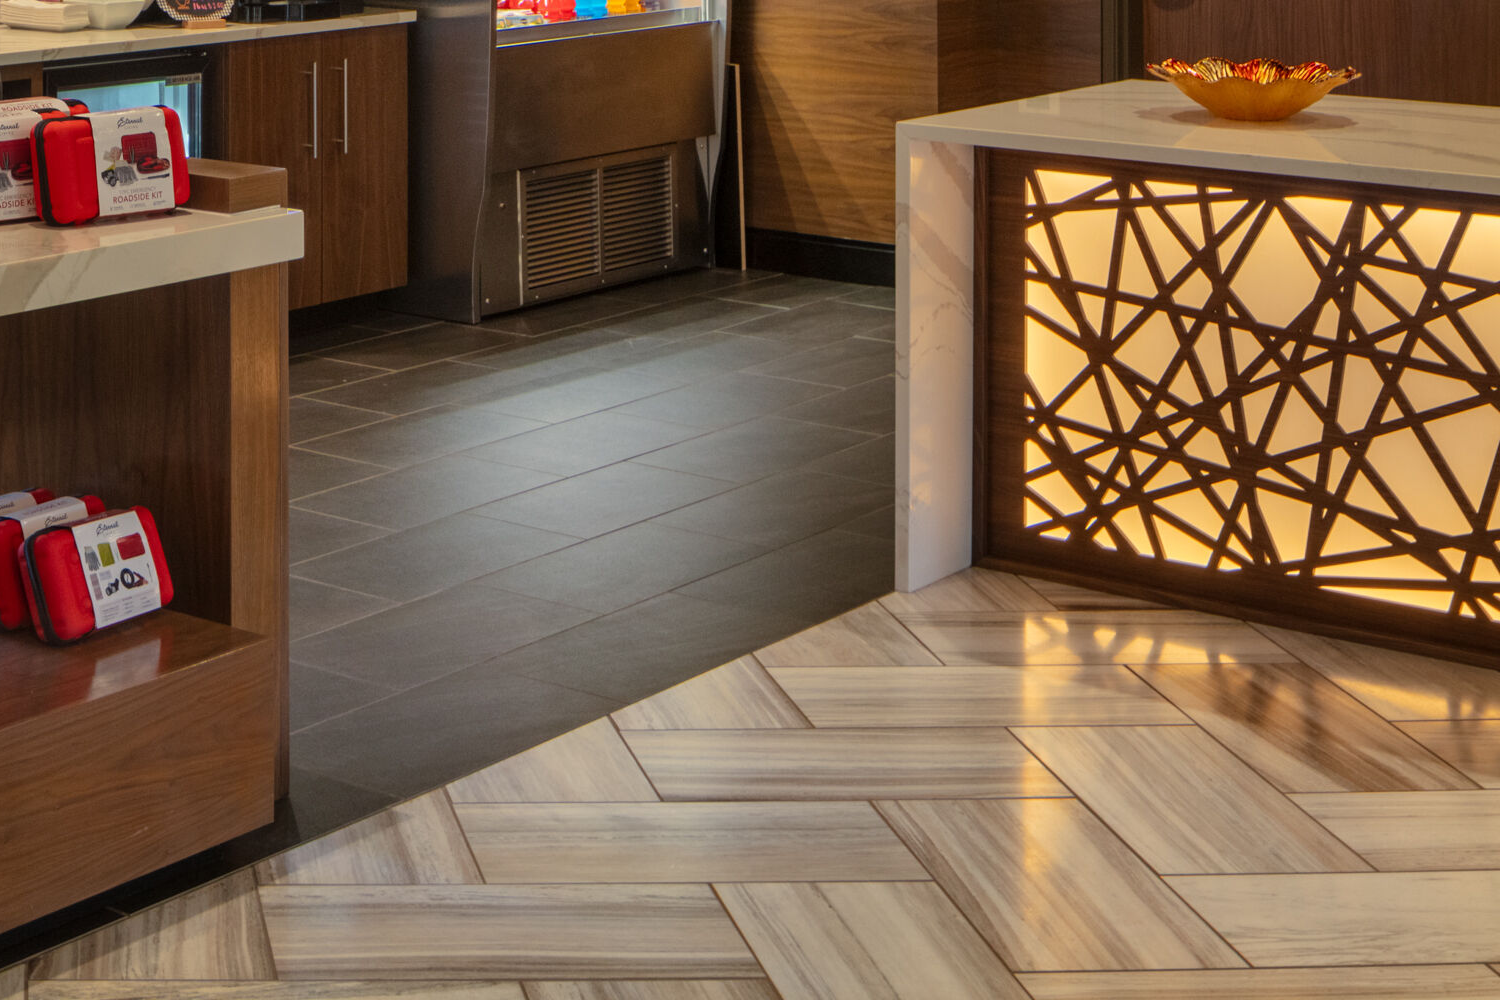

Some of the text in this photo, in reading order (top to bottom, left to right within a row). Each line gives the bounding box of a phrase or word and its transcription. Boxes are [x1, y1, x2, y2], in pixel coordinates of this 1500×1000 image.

[117, 116, 144, 129] Eternal
[113, 191, 163, 204] ROADSIDE KIT
